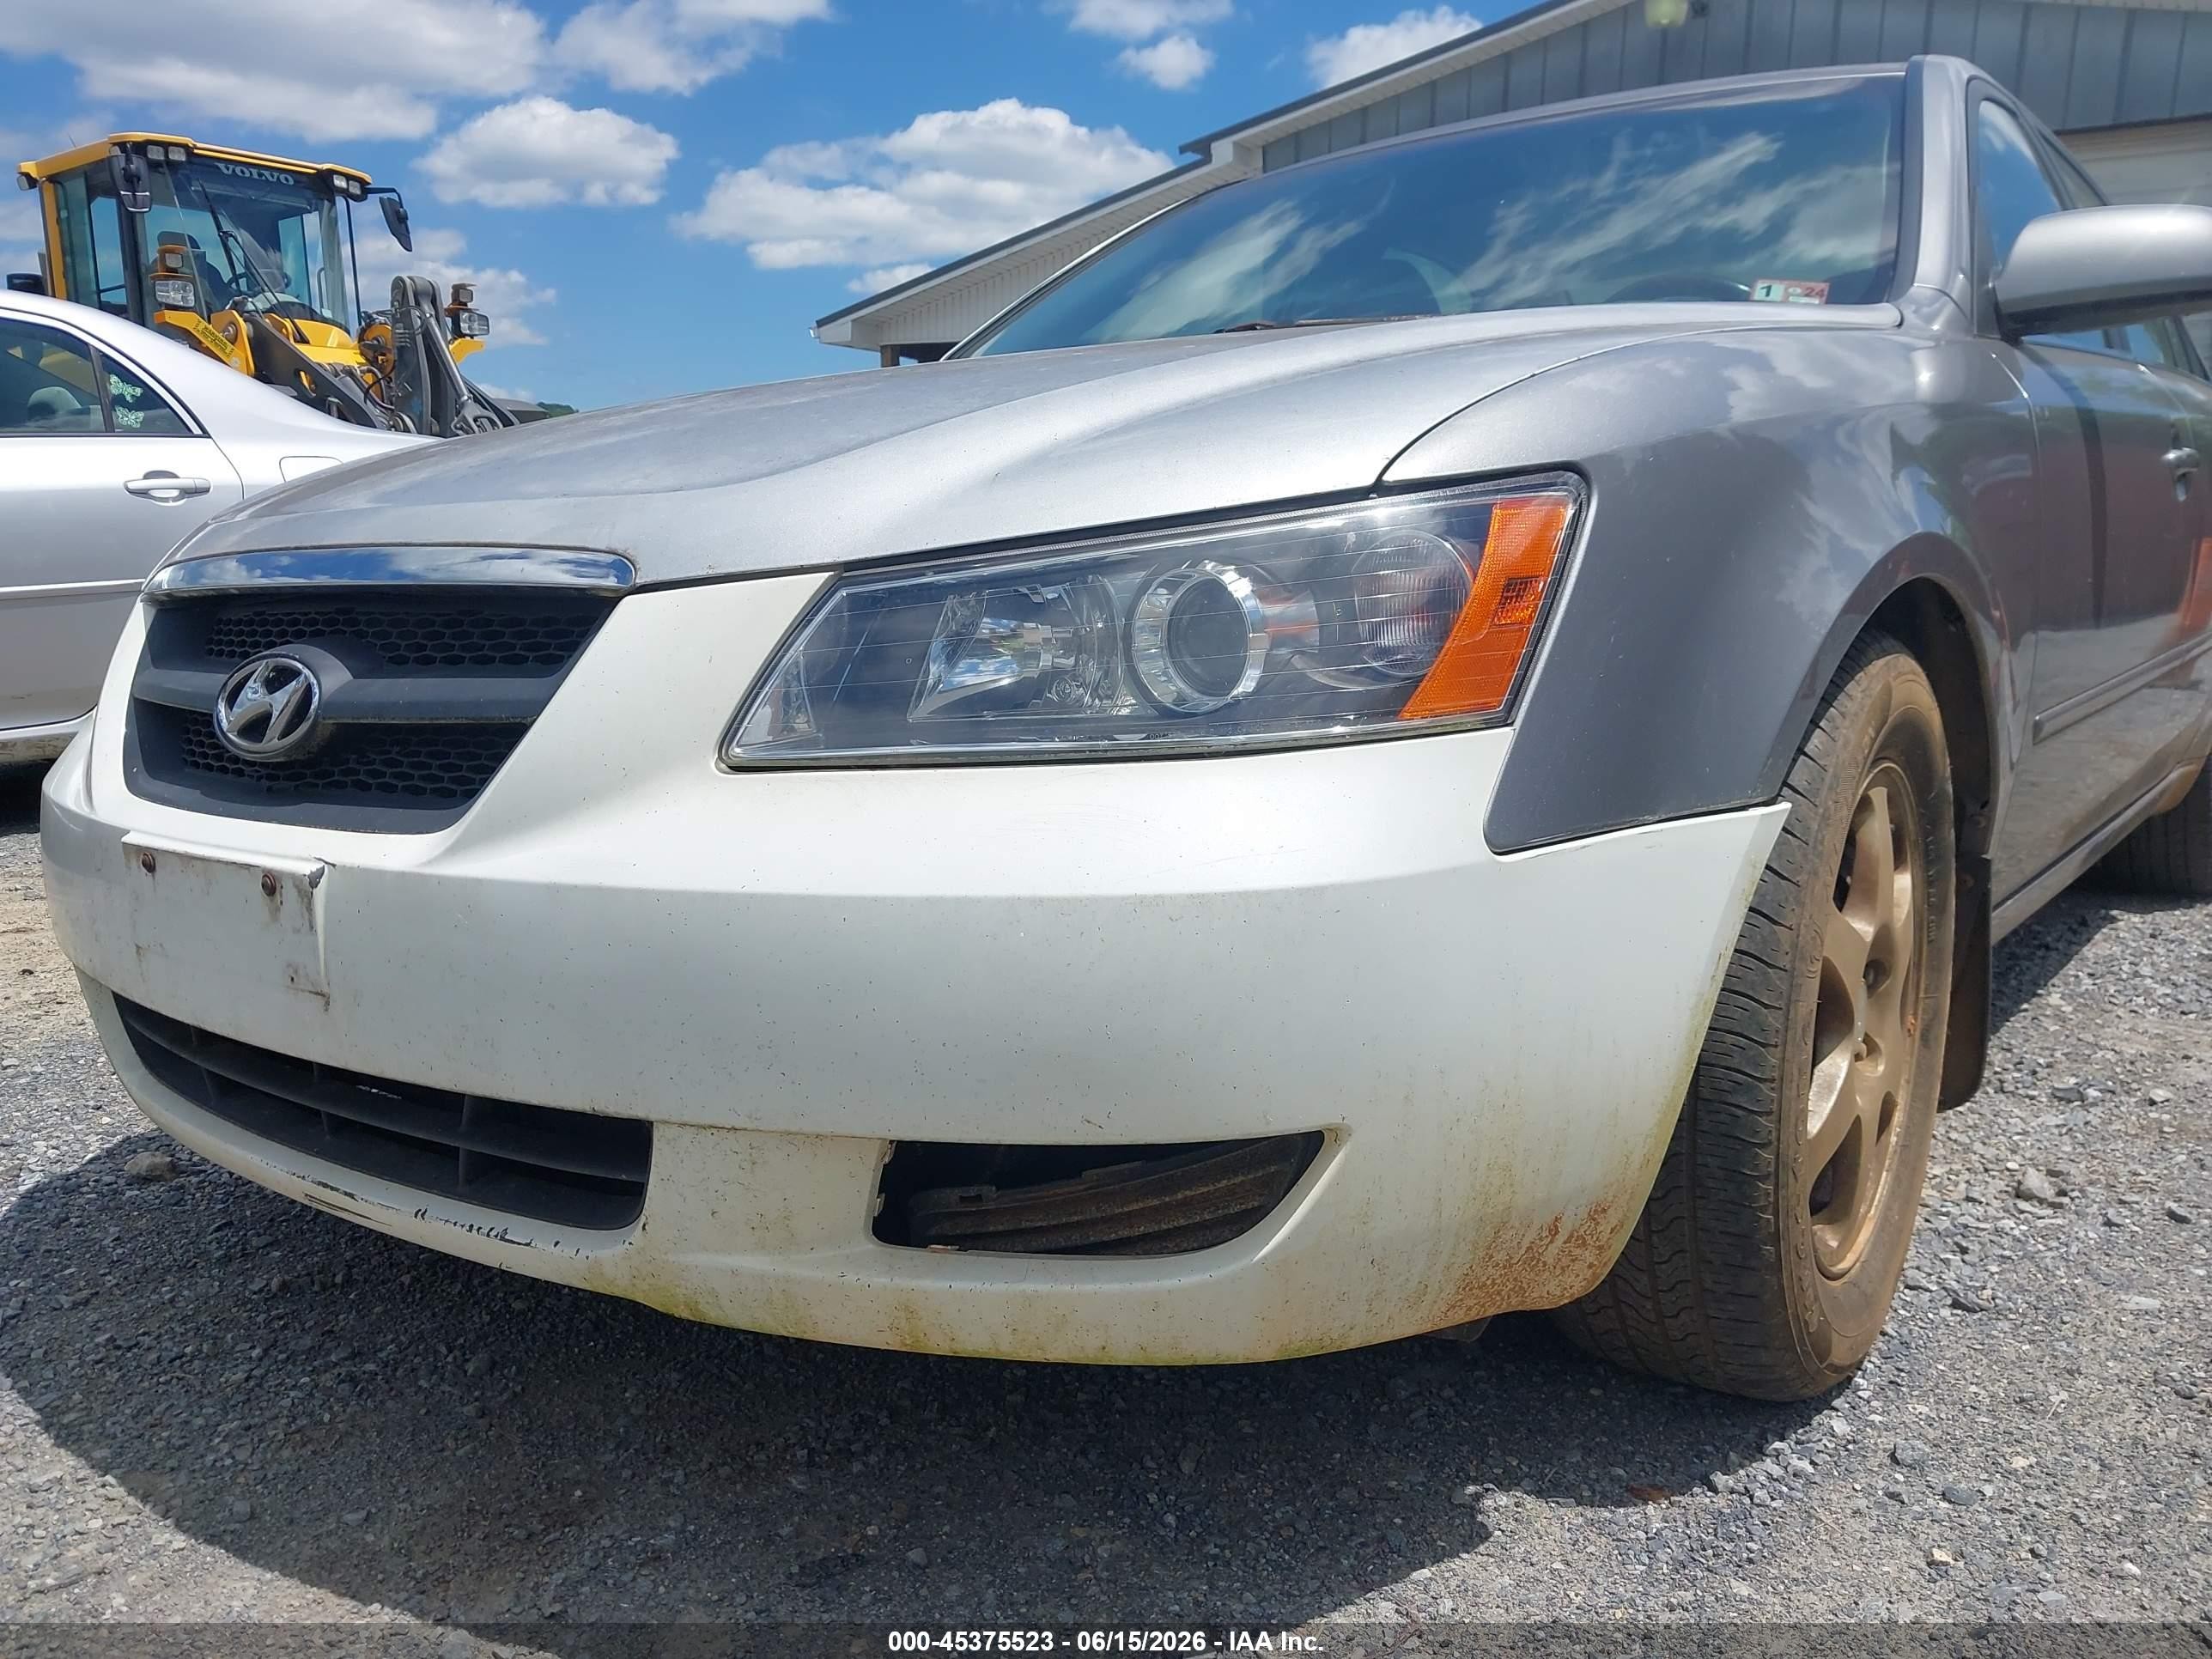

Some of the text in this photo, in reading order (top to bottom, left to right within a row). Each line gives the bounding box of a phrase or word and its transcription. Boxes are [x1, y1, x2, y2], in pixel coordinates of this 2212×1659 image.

[214, 162, 294, 185] VOLVO
[1759, 284, 1825, 298] 1 24
